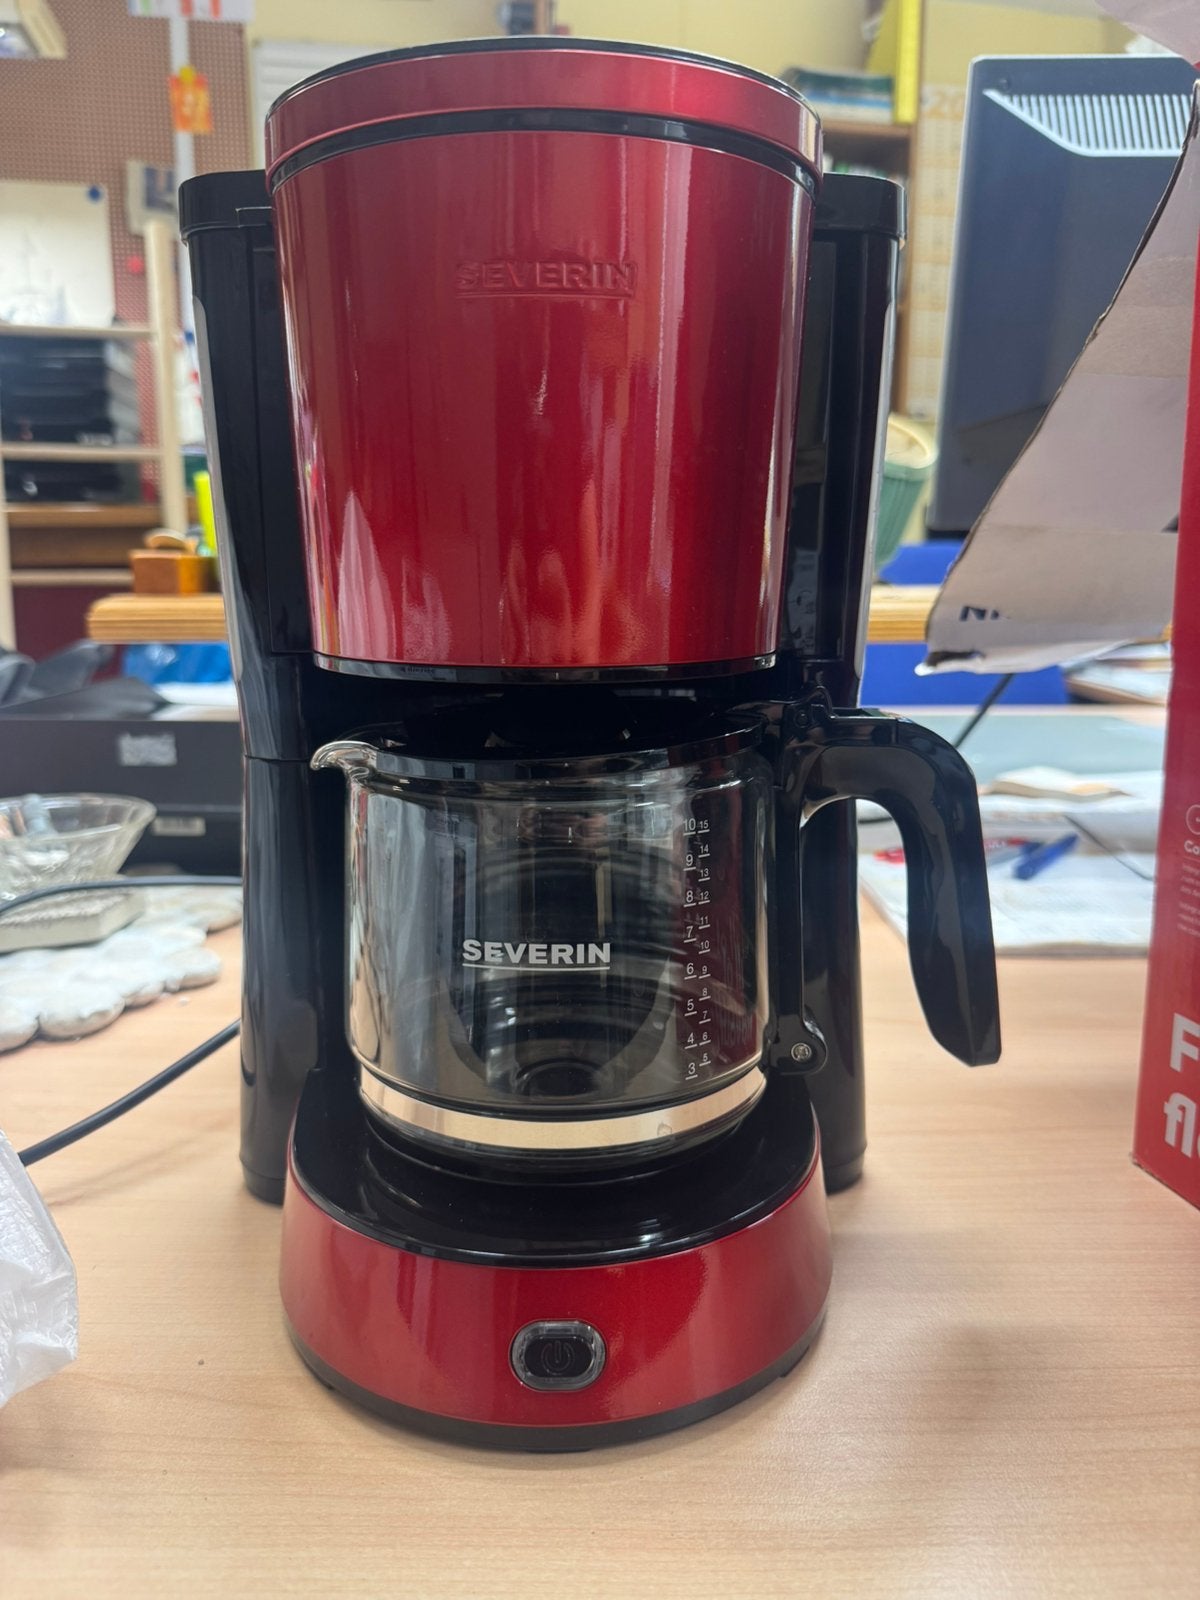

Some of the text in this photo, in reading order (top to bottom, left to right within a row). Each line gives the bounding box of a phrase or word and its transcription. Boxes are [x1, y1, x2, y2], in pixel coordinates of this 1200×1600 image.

[457, 261, 638, 290] SEVERIN
[683, 818, 709, 831] 10 15
[700, 844, 709, 854] 14
[686, 854, 693, 866] 9
[700, 868, 709, 878] 13
[686, 890, 709, 903] 8 12
[700, 915, 709, 925] 11
[686, 926, 694, 938] 7
[700, 940, 710, 950] 10
[462, 938, 611, 965] SEVERIN
[686, 962, 694, 975] 6
[687, 999, 694, 1011] 5
[687, 1032, 694, 1045] 4
[688, 1062, 696, 1075] 3
